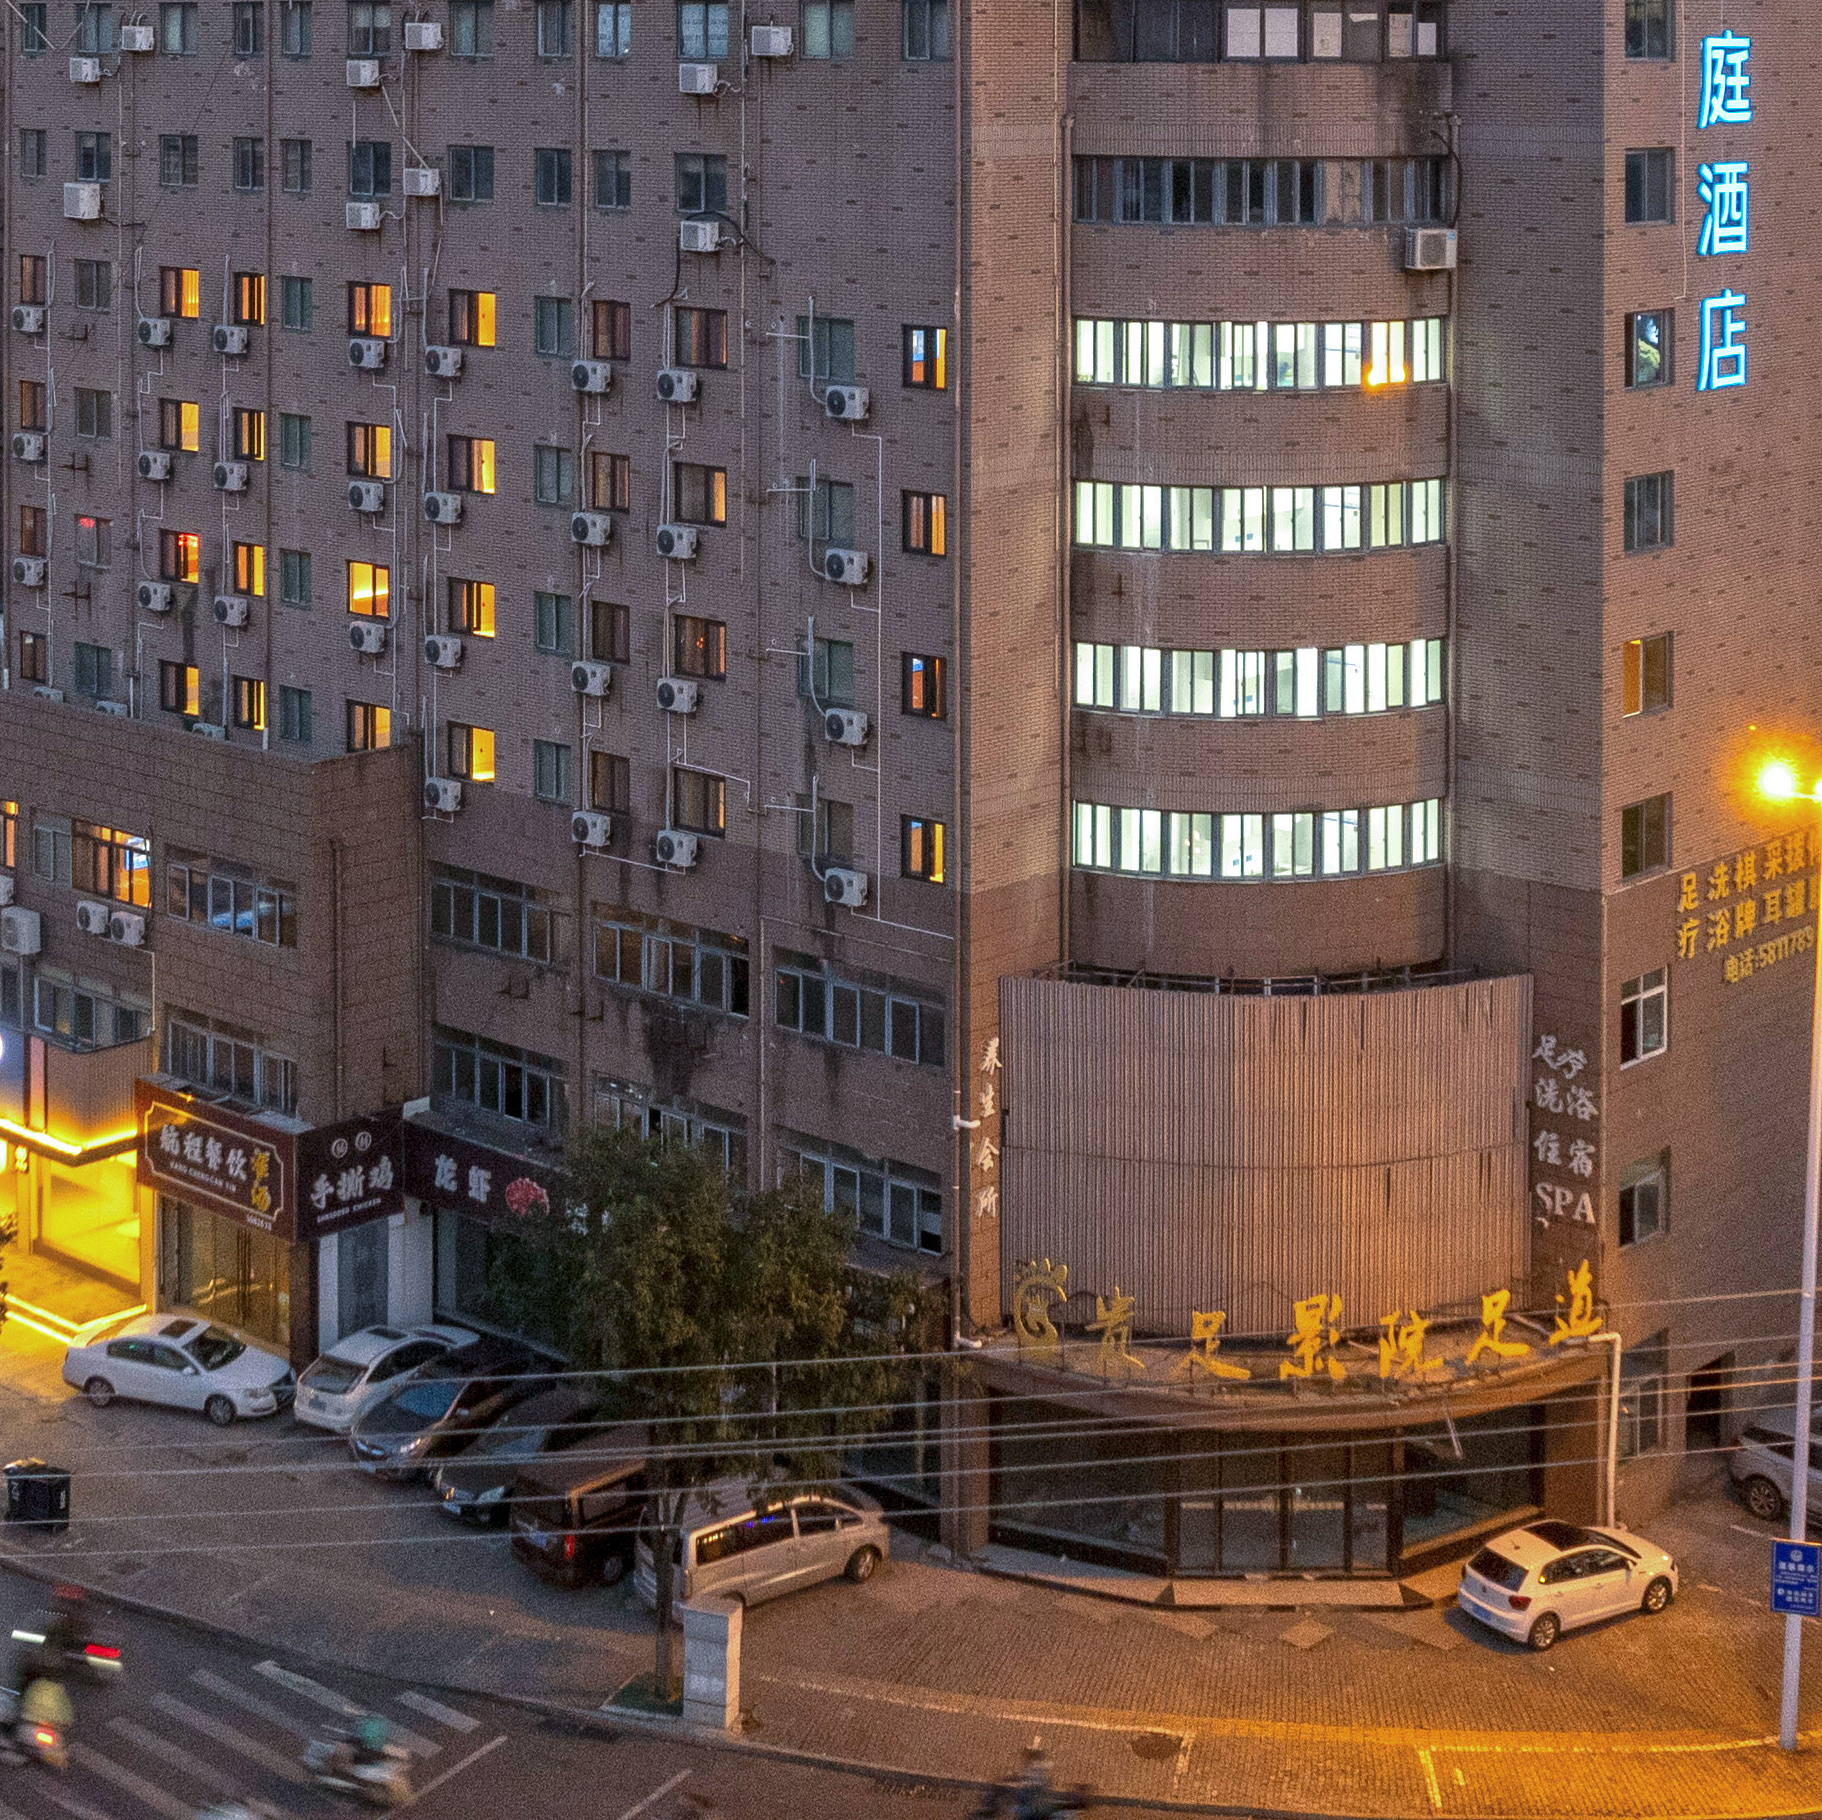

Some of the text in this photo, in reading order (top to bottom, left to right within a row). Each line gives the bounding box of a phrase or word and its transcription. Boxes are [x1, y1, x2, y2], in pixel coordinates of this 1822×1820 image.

[1532, 1034, 1588, 1080] 足疗
[1535, 1077, 1599, 1121] 洗浴
[975, 1036, 1003, 1218] 养生会所
[160, 1124, 247, 1182] 航程餐饮
[1533, 1130, 1596, 1178] 住宿
[310, 1154, 394, 1211] 手撕鸡
[434, 1153, 492, 1203] 龙虾
[1535, 1181, 1597, 1225] SPA
